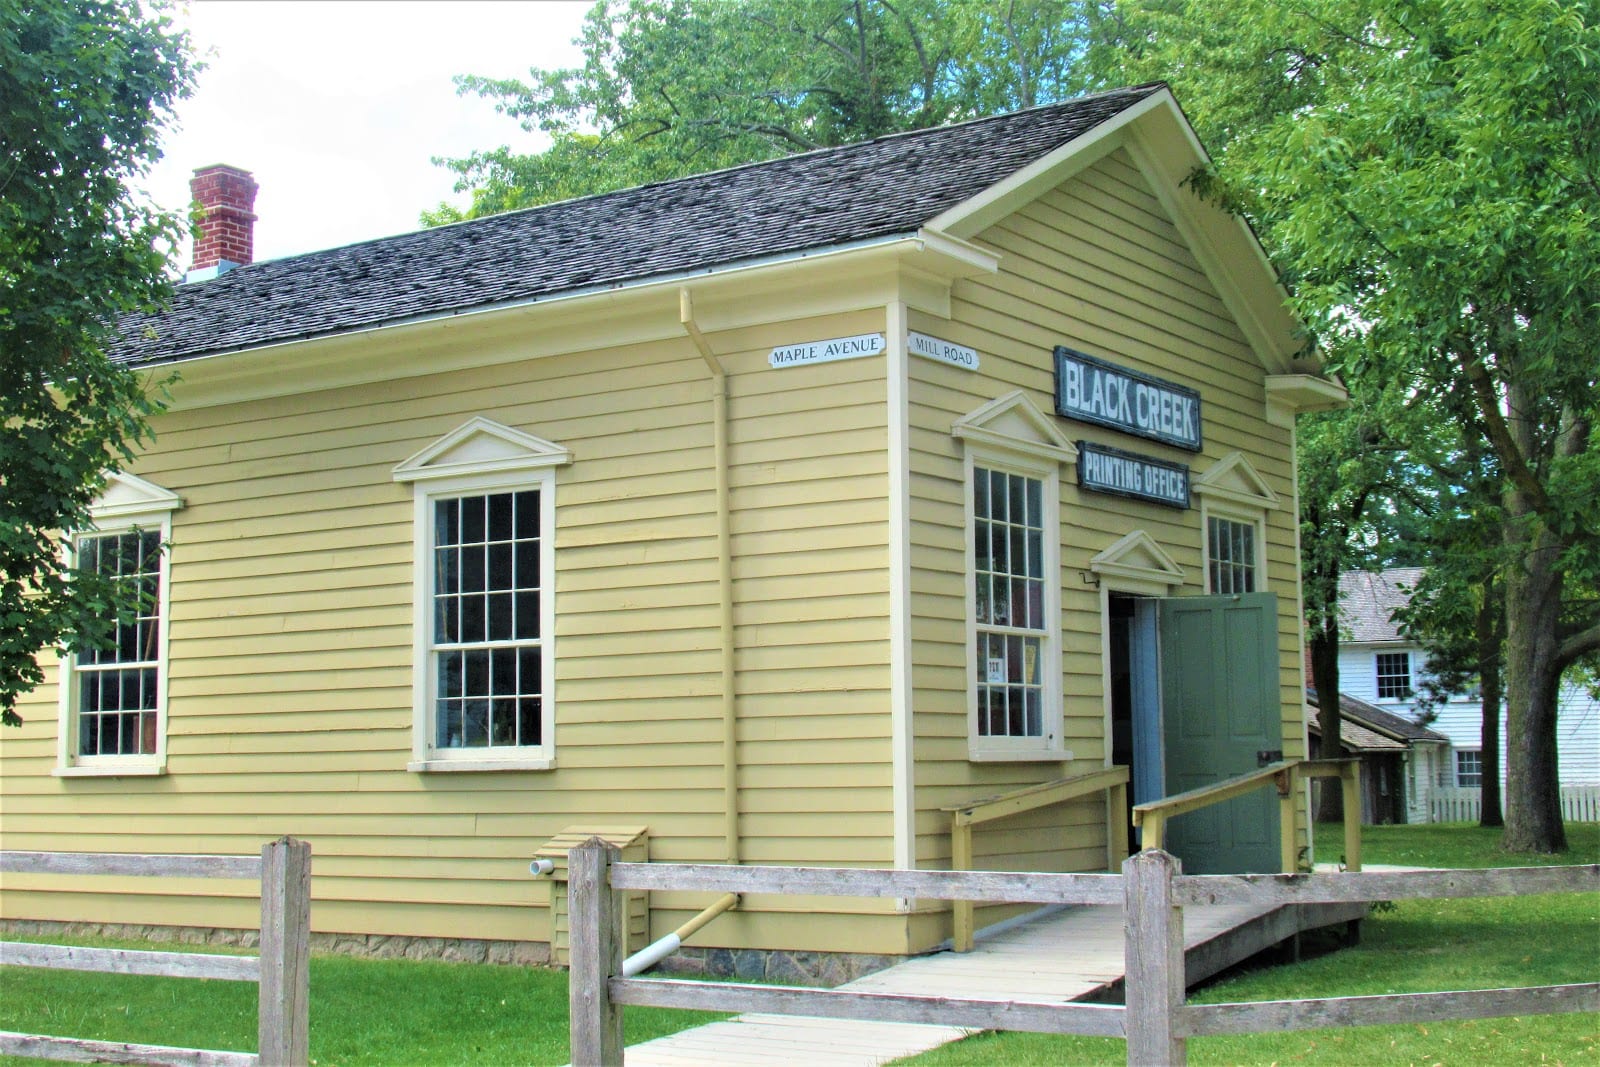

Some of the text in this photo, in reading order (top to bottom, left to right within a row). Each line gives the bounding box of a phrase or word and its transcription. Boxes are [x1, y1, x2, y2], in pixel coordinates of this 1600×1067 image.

[773, 337, 879, 364] MAPLE AVENUE
[915, 337, 973, 365] MILL ROAD
[1065, 359, 1196, 441] BLACK CREEK
[1085, 451, 1185, 500] PRINTING OFFICE
